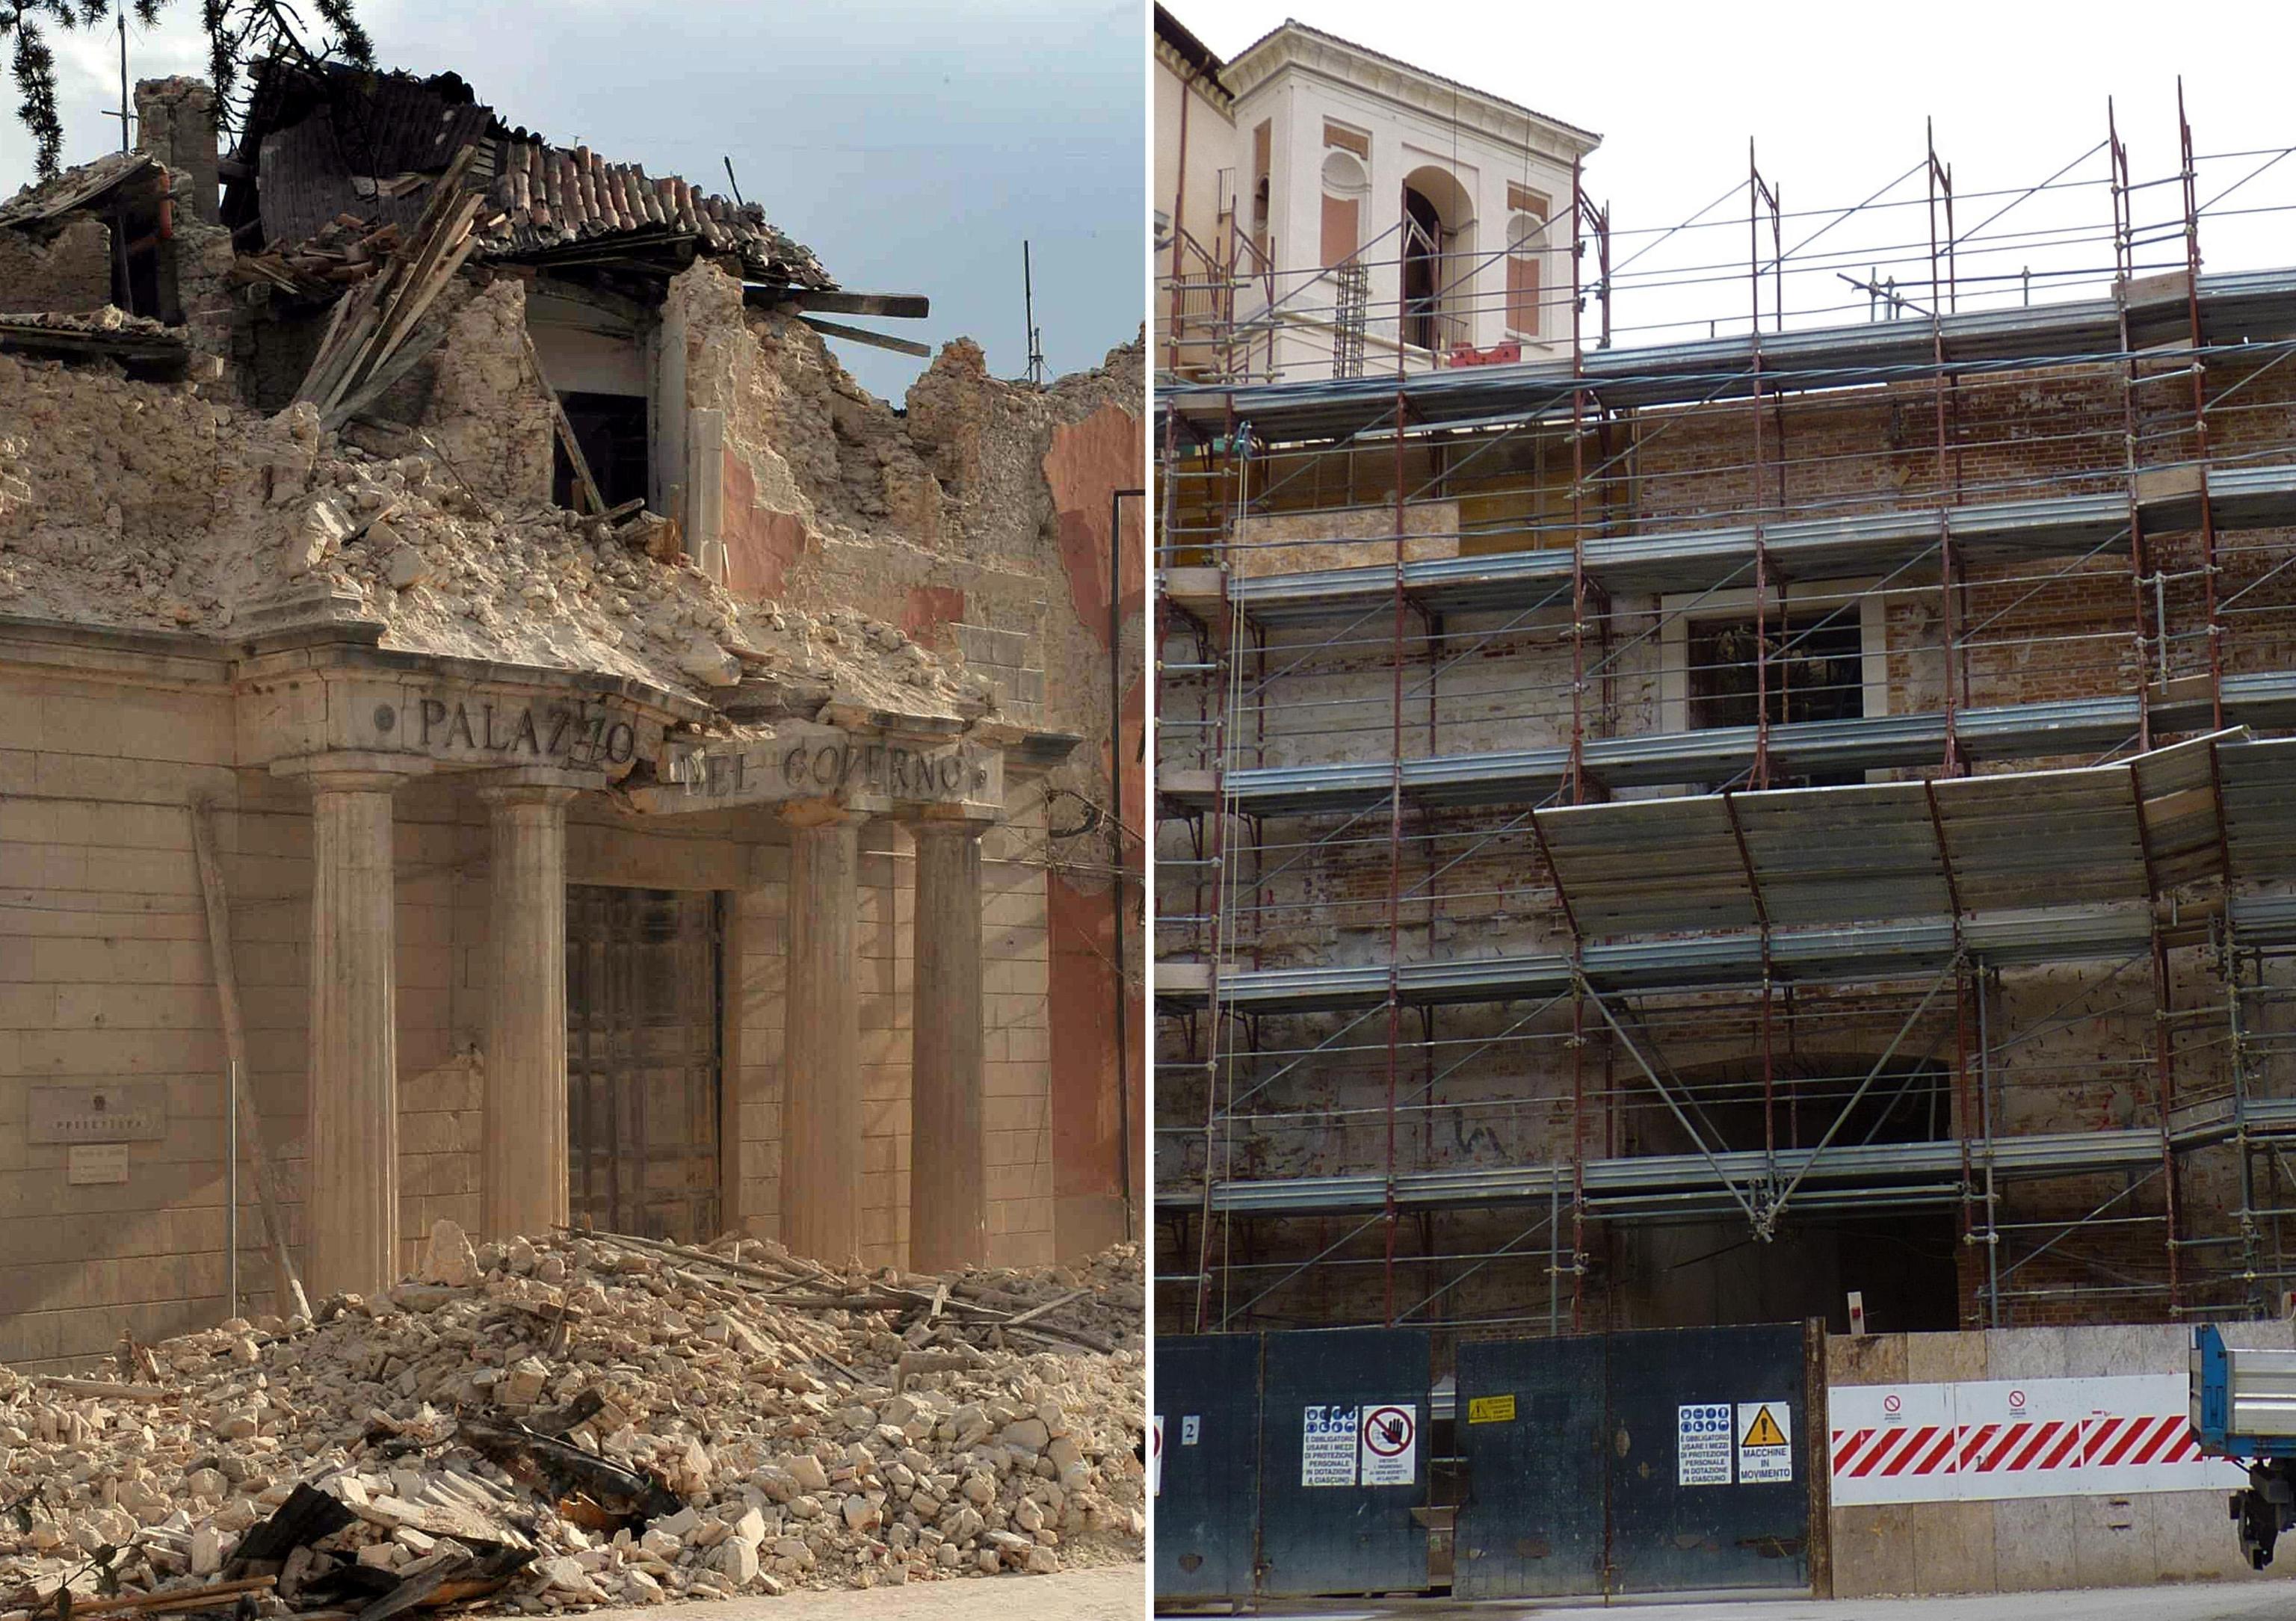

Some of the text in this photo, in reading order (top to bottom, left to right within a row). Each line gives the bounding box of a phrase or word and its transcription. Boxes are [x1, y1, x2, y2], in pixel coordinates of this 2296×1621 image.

[419, 698, 635, 764] PALAZZO
[783, 741, 962, 793] GOVERNO
[1185, 1424, 1194, 1438] 2
[1743, 1448, 1786, 1457] MACCHINE
[1761, 1459, 1769, 1467] IN
[1691, 1475, 1726, 1483] CIASCUNO
[1741, 1469, 1790, 1479] MOVIMENTO
